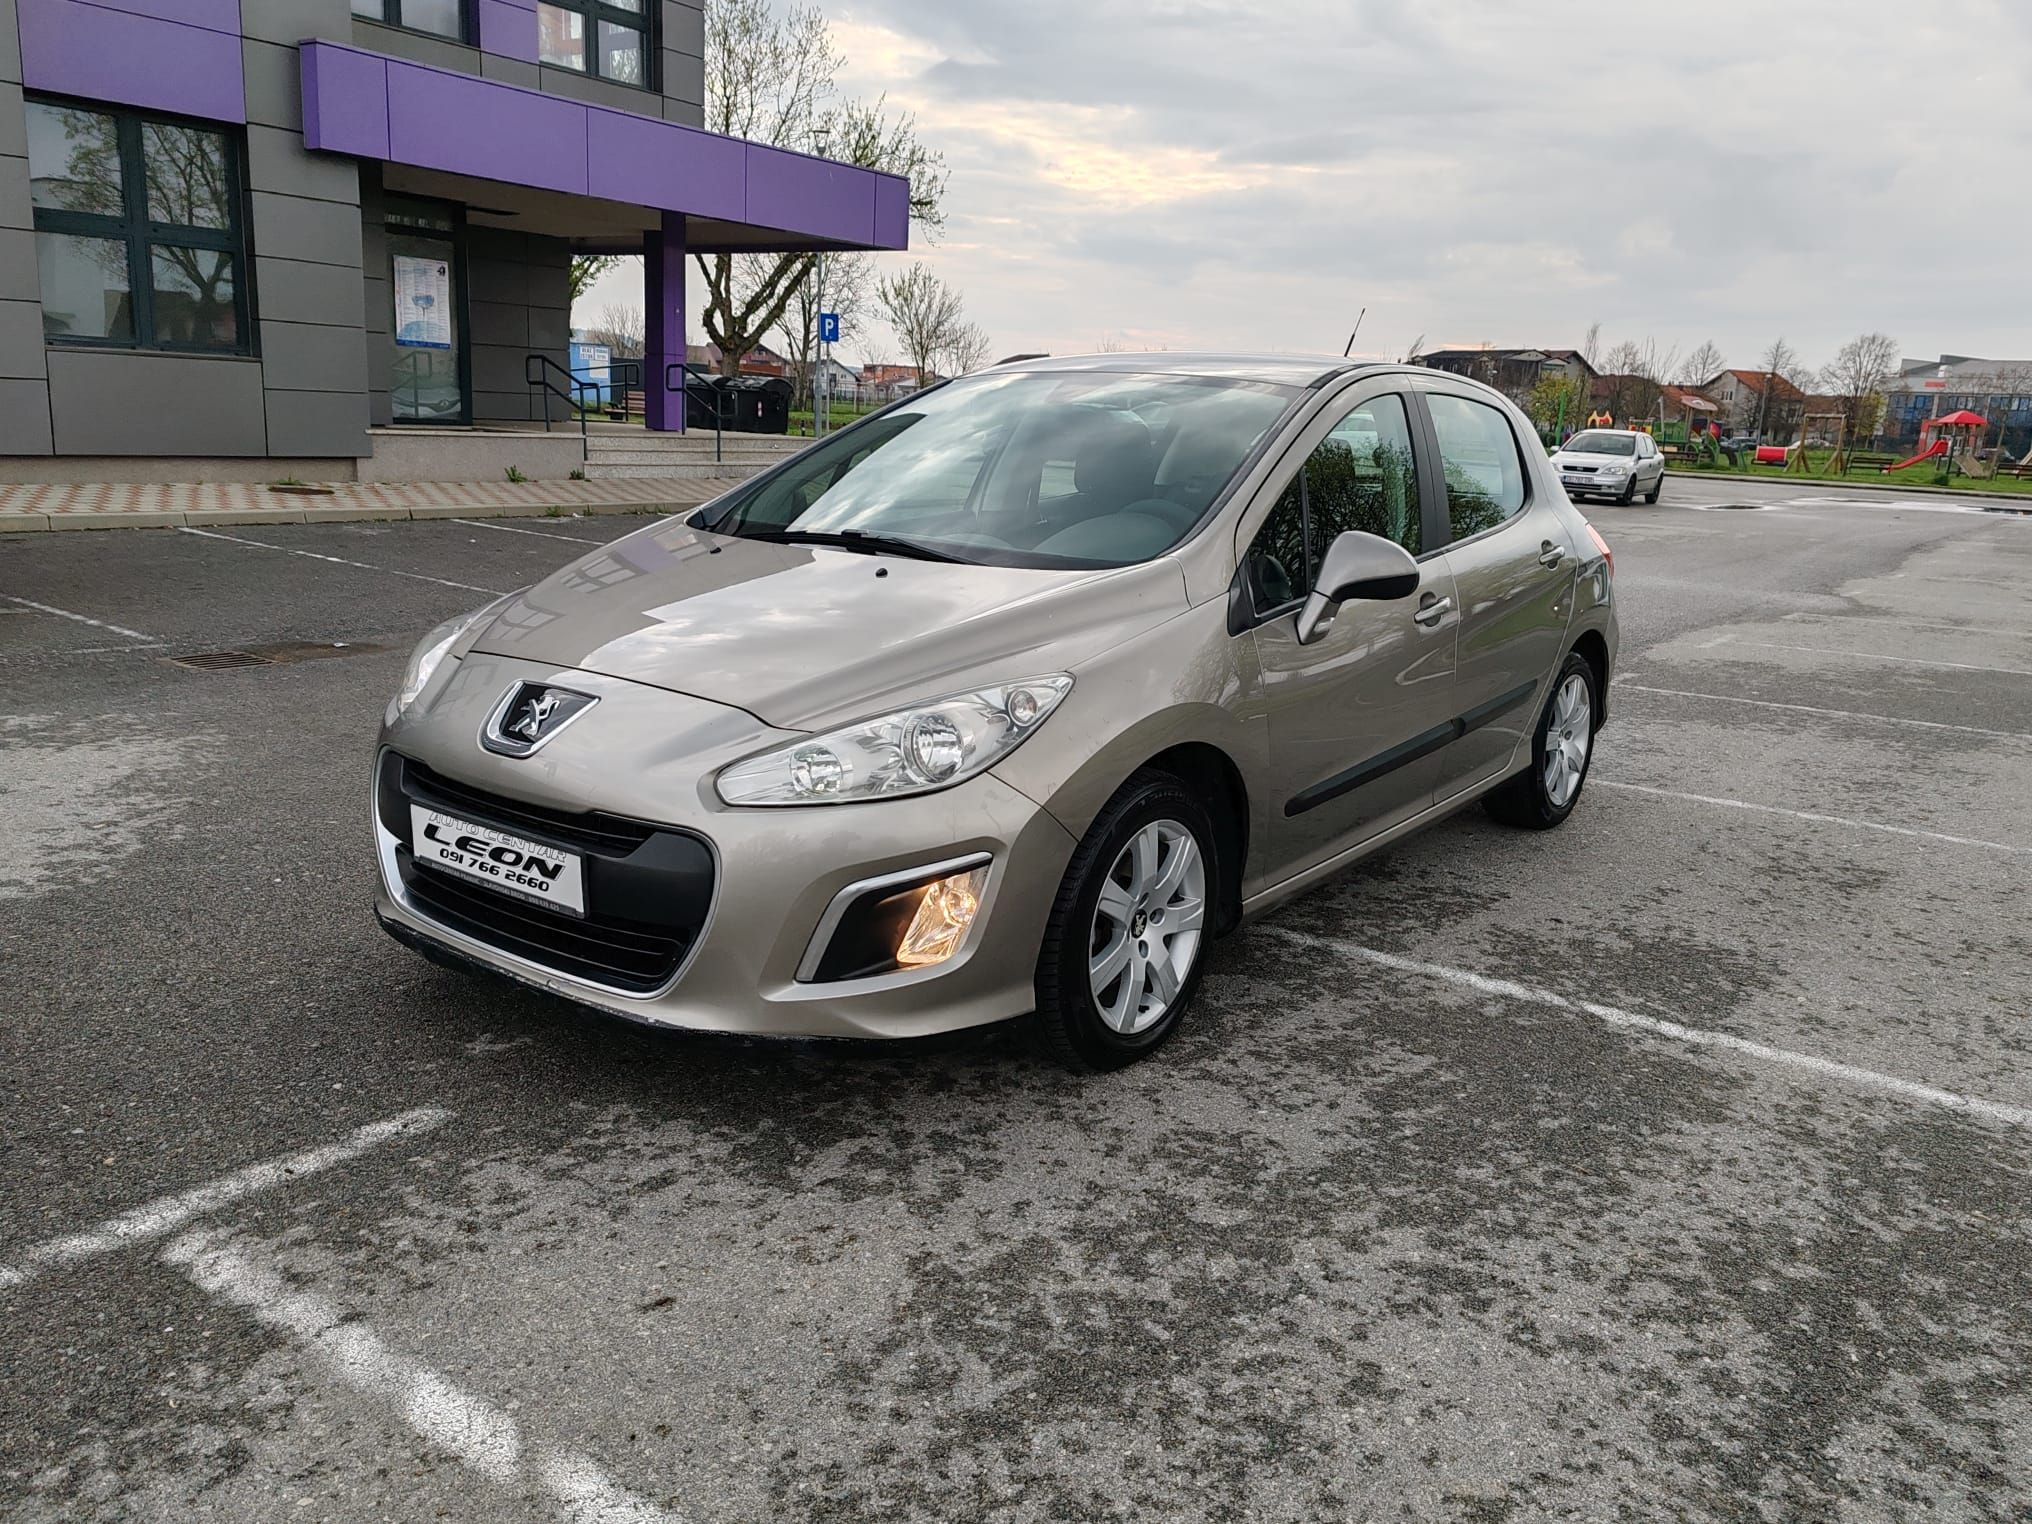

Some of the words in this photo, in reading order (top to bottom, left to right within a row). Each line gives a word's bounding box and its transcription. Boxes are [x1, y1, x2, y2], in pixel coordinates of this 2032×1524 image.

[825, 318, 834, 336] P
[423, 823, 566, 881] LEON
[428, 812, 480, 835] AUTO
[482, 828, 568, 863] CENTAR
[439, 848, 464, 864] 091
[468, 857, 501, 876] 766
[504, 869, 550, 892] 2660
